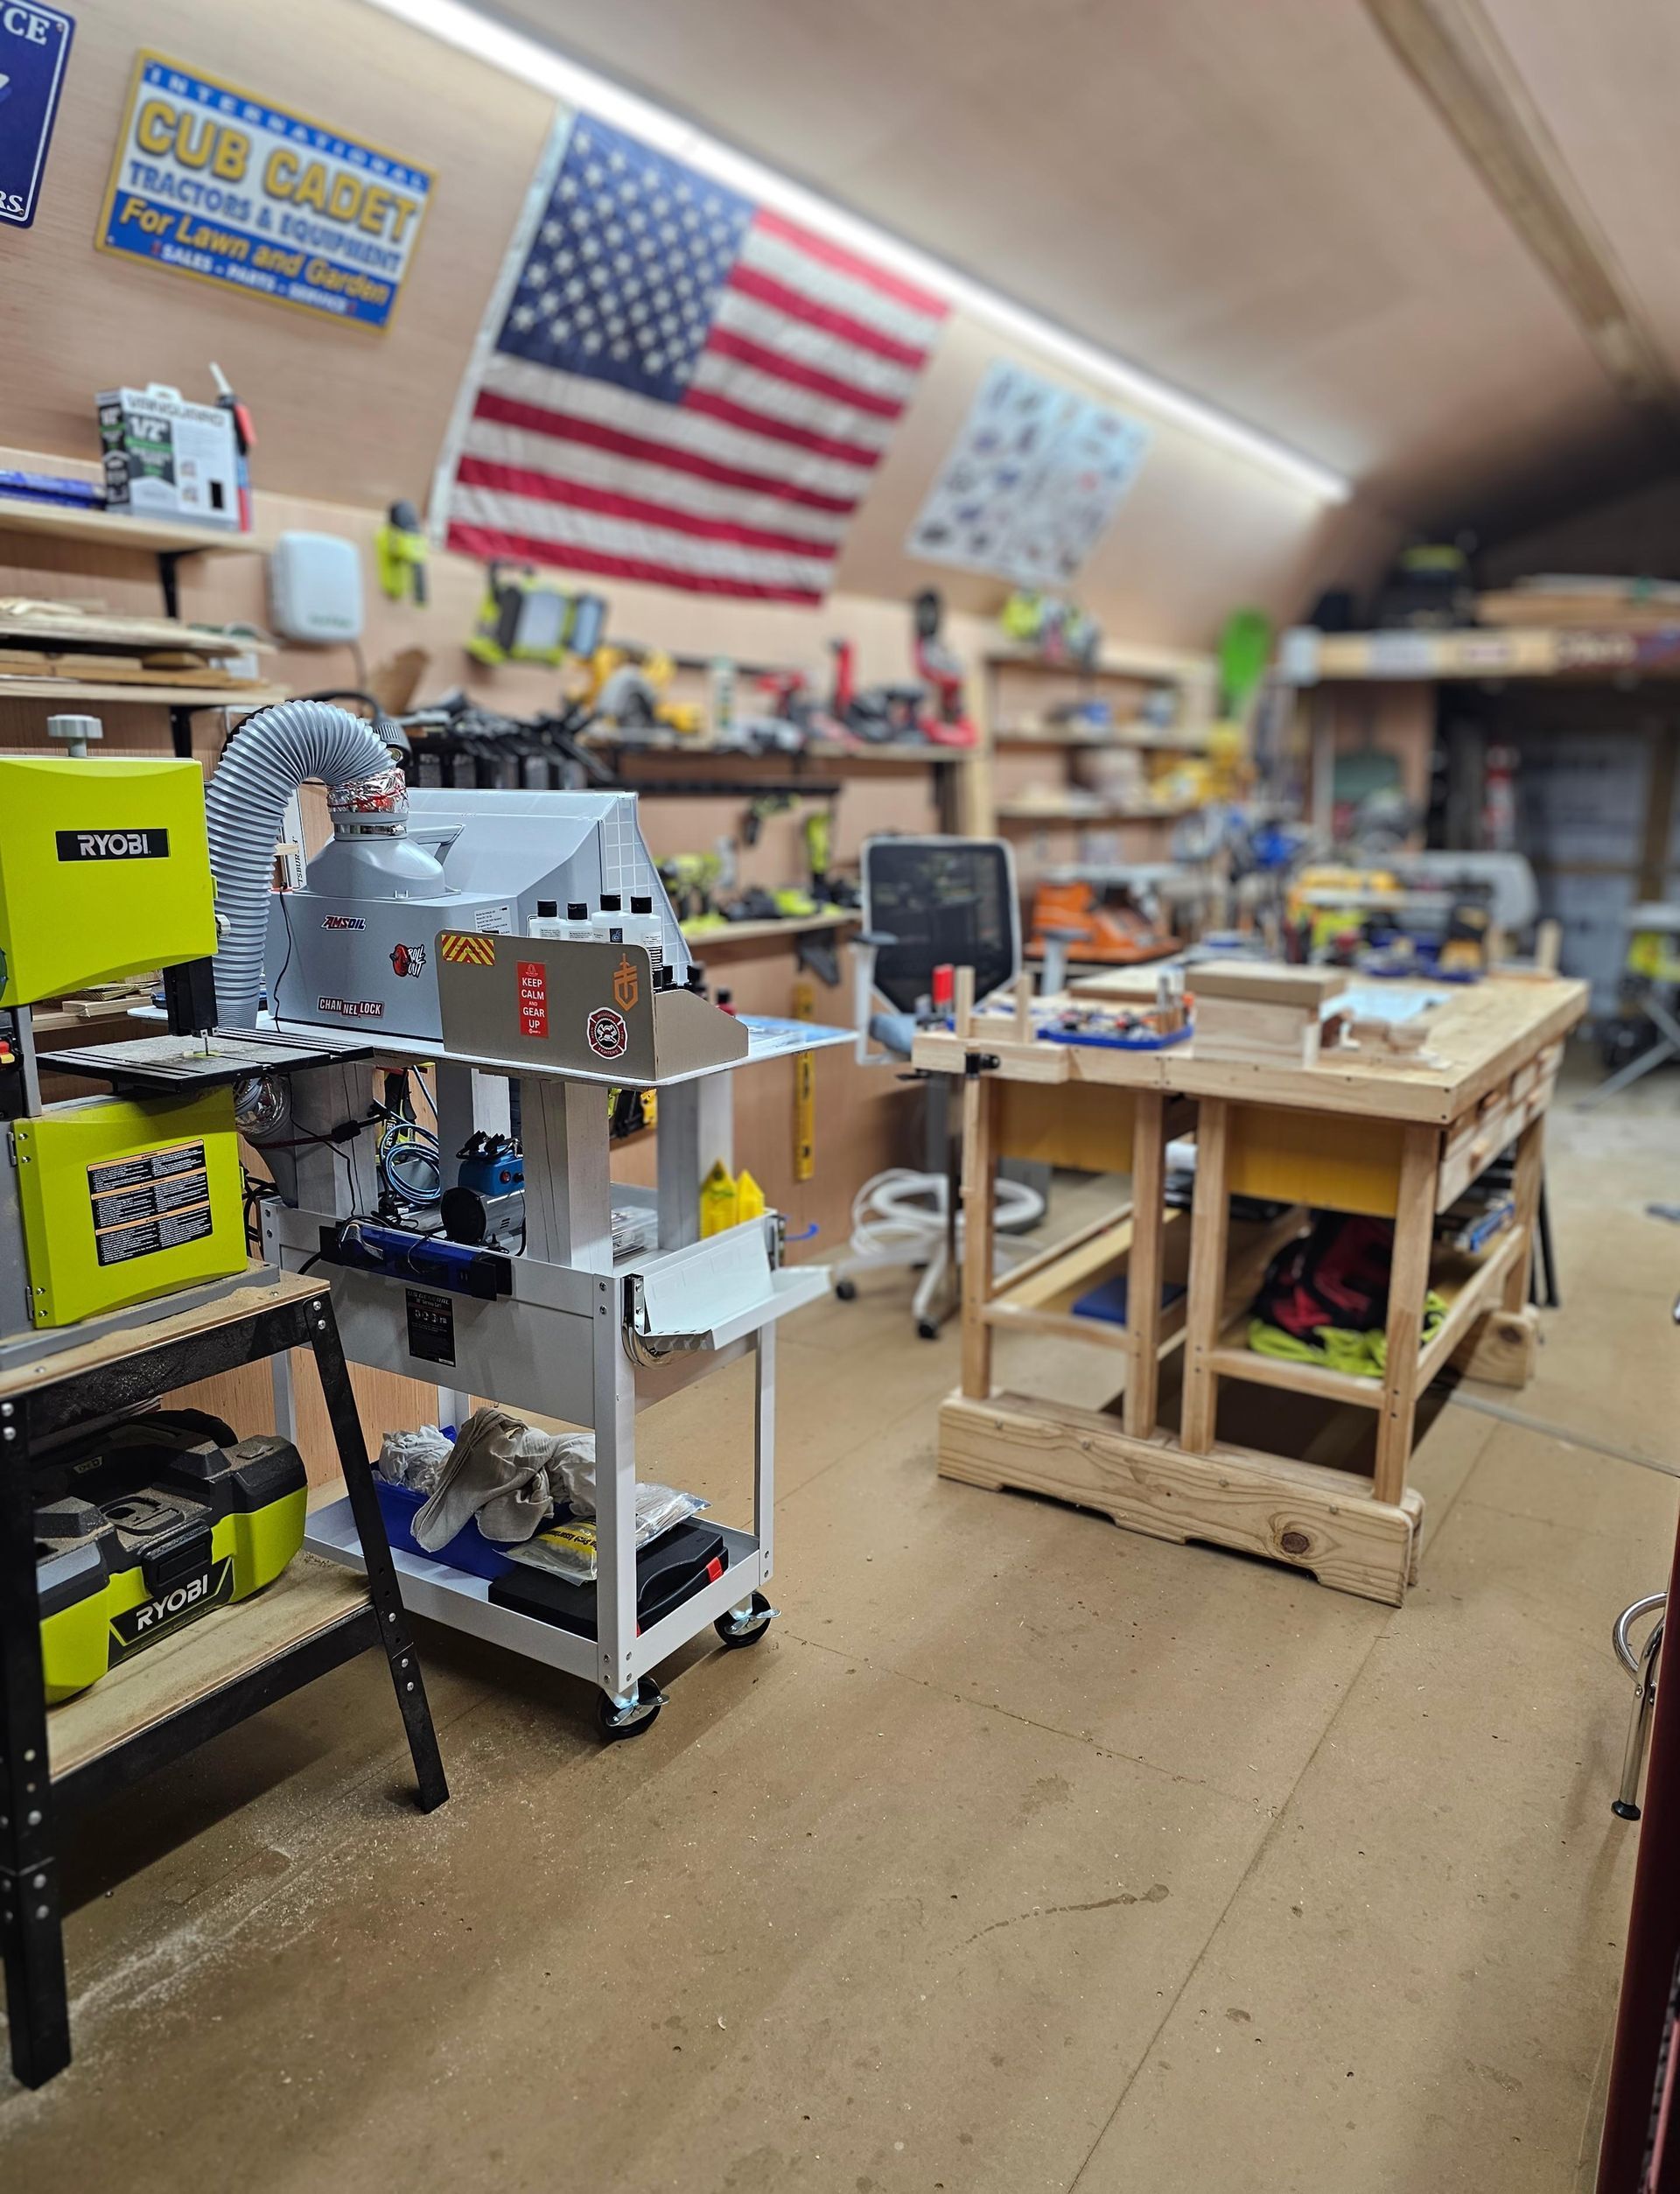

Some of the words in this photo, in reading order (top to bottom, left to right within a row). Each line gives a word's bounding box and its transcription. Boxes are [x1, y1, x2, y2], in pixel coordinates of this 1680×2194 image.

[0, 0, 51, 46] CE
[136, 98, 250, 184] CUB
[262, 149, 419, 244] CADET
[130, 160, 252, 222] TRACTORS
[256, 207, 272, 230] &
[120, 197, 174, 235] For
[175, 211, 250, 261] Lawn
[252, 245, 306, 278] and
[305, 257, 390, 305] Garden
[160, 242, 214, 273] SALES
[77, 833, 149, 856] RYOBI
[323, 915, 367, 930] AMSOIL
[408, 945, 425, 963] ROLL
[408, 961, 425, 978] OUT
[522, 978, 542, 988] KEEP
[521, 990, 544, 1000] CALM
[522, 1007, 545, 1018] GEAR
[528, 1019, 541, 1028] UP
[386, 1122, 396, 1146] RYBI
[136, 1574, 208, 1631] RYOBI
